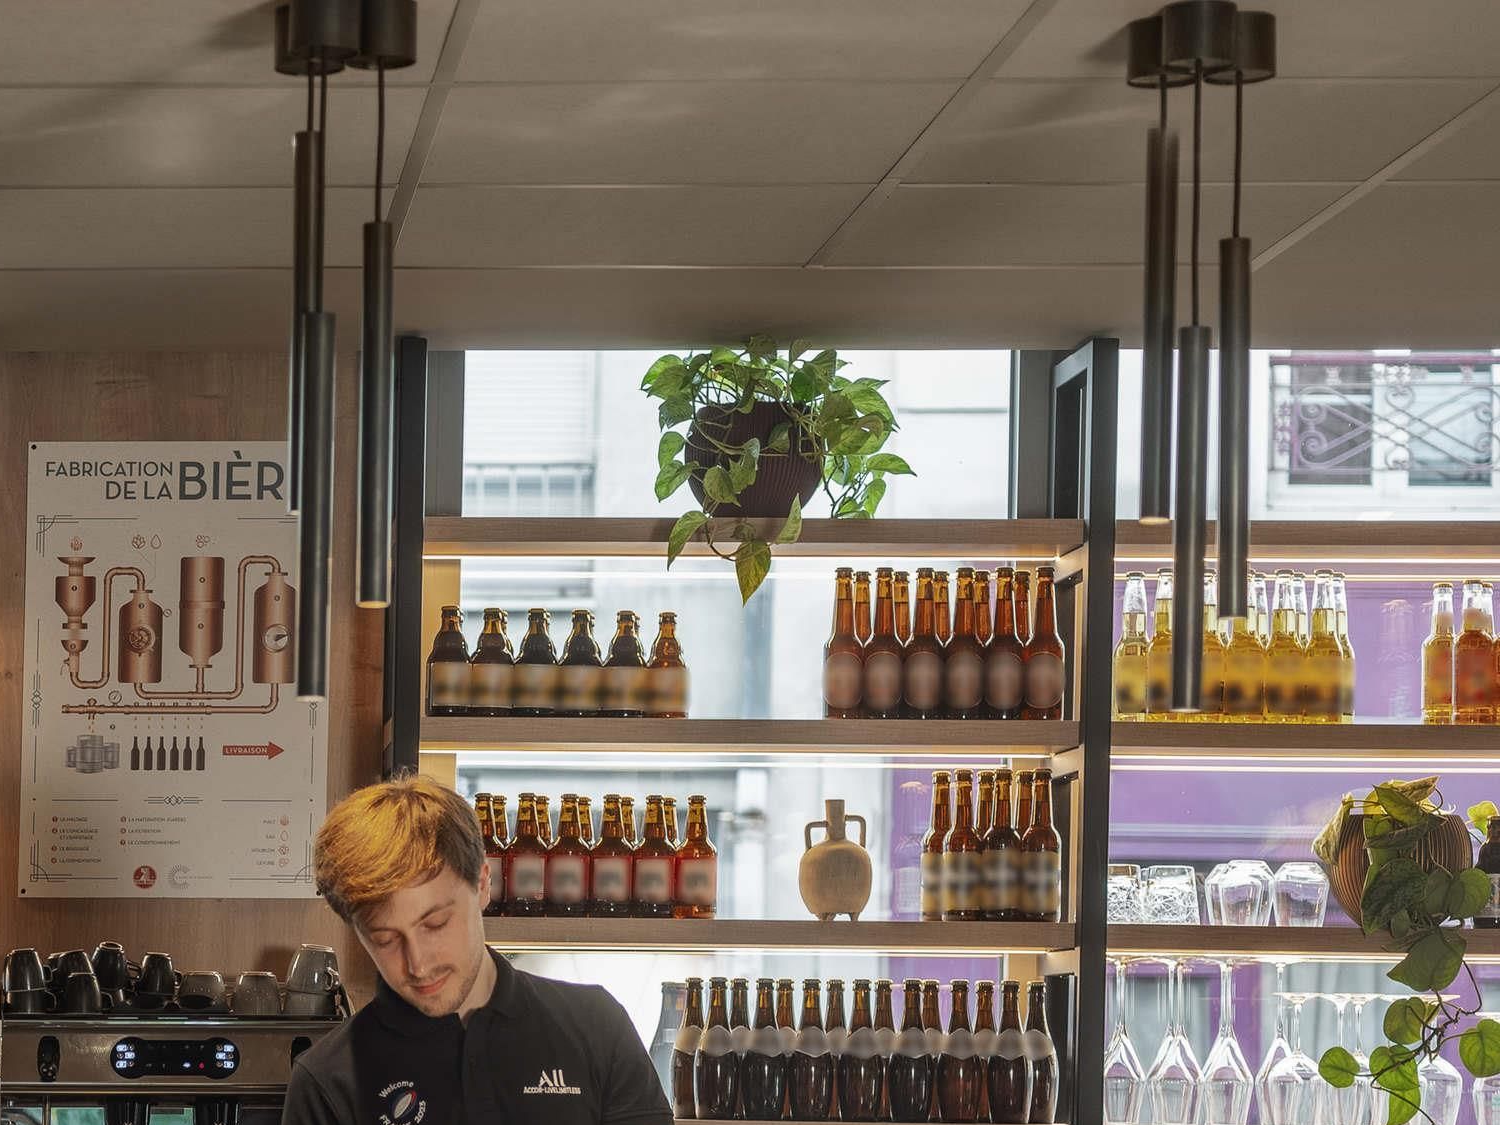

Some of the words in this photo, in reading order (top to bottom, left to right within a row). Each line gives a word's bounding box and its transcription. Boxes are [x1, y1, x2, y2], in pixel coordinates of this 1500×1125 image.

[45, 461, 173, 477] FABRICATION
[178, 450, 285, 501] BIÈR
[105, 480, 137, 500] DE
[143, 480, 173, 500] LA
[225, 745, 268, 754] LIVRAISON
[378, 1081, 414, 1098] Welcome
